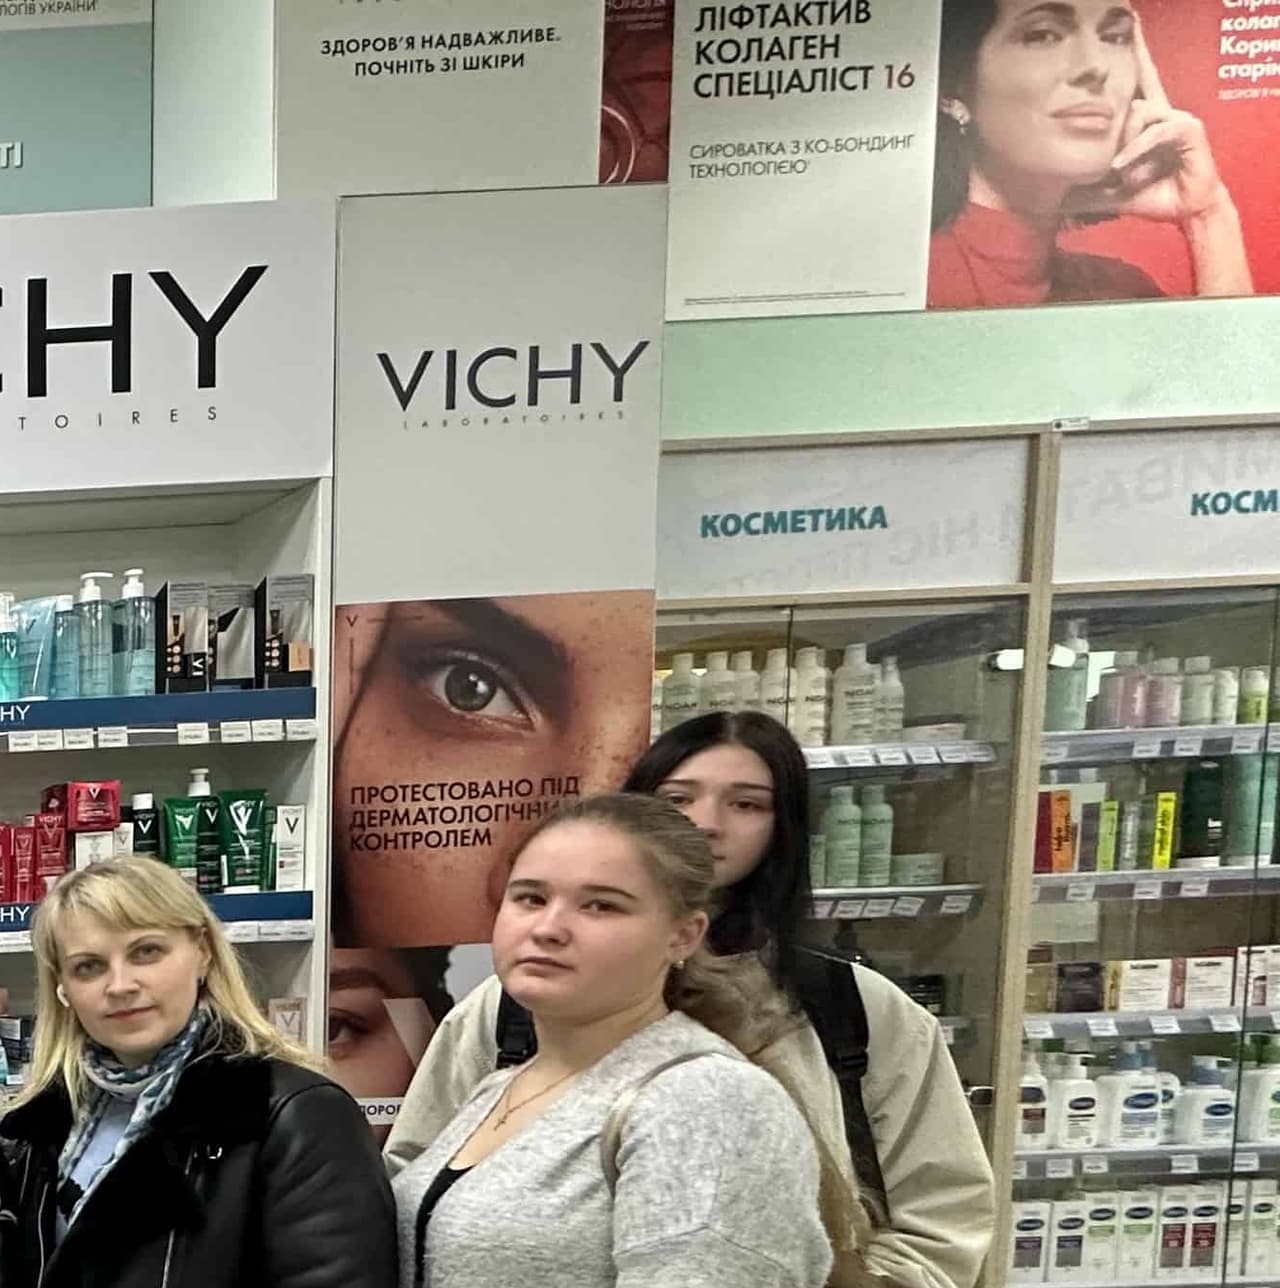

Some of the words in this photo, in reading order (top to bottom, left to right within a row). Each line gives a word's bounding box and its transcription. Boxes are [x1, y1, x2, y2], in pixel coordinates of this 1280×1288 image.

[40, 0, 96, 15] УКРАЇНИ
[695, 0, 872, 32] ЛІФТАКТИВ
[320, 36, 415, 58] ЗДОРОВ'Я
[695, 33, 841, 66] КОЛАГЕН
[354, 59, 435, 77] ПОЧНІТЬ
[440, 57, 457, 73] ЗІ
[462, 53, 526, 72] ШКІРИ
[693, 65, 874, 100] СПЕЦІАЛІСТ
[884, 63, 916, 90] 16
[689, 141, 787, 160] СИРОВАТКА
[804, 134, 916, 154] КО-БОНДИНГ
[376, 340, 651, 412] VICHY
[403, 410, 624, 430] LABORATOIRES
[1189, 489, 1280, 517] КОСМ
[700, 504, 889, 539] КОСМЕТИКА
[350, 777, 534, 806] ПРОТЕСТОВАНО
[540, 776, 581, 797] ПІД
[348, 797, 568, 829] ДЕРМАТОЛОГІЧН
[350, 829, 492, 851] КОНТРОЛЕМ
